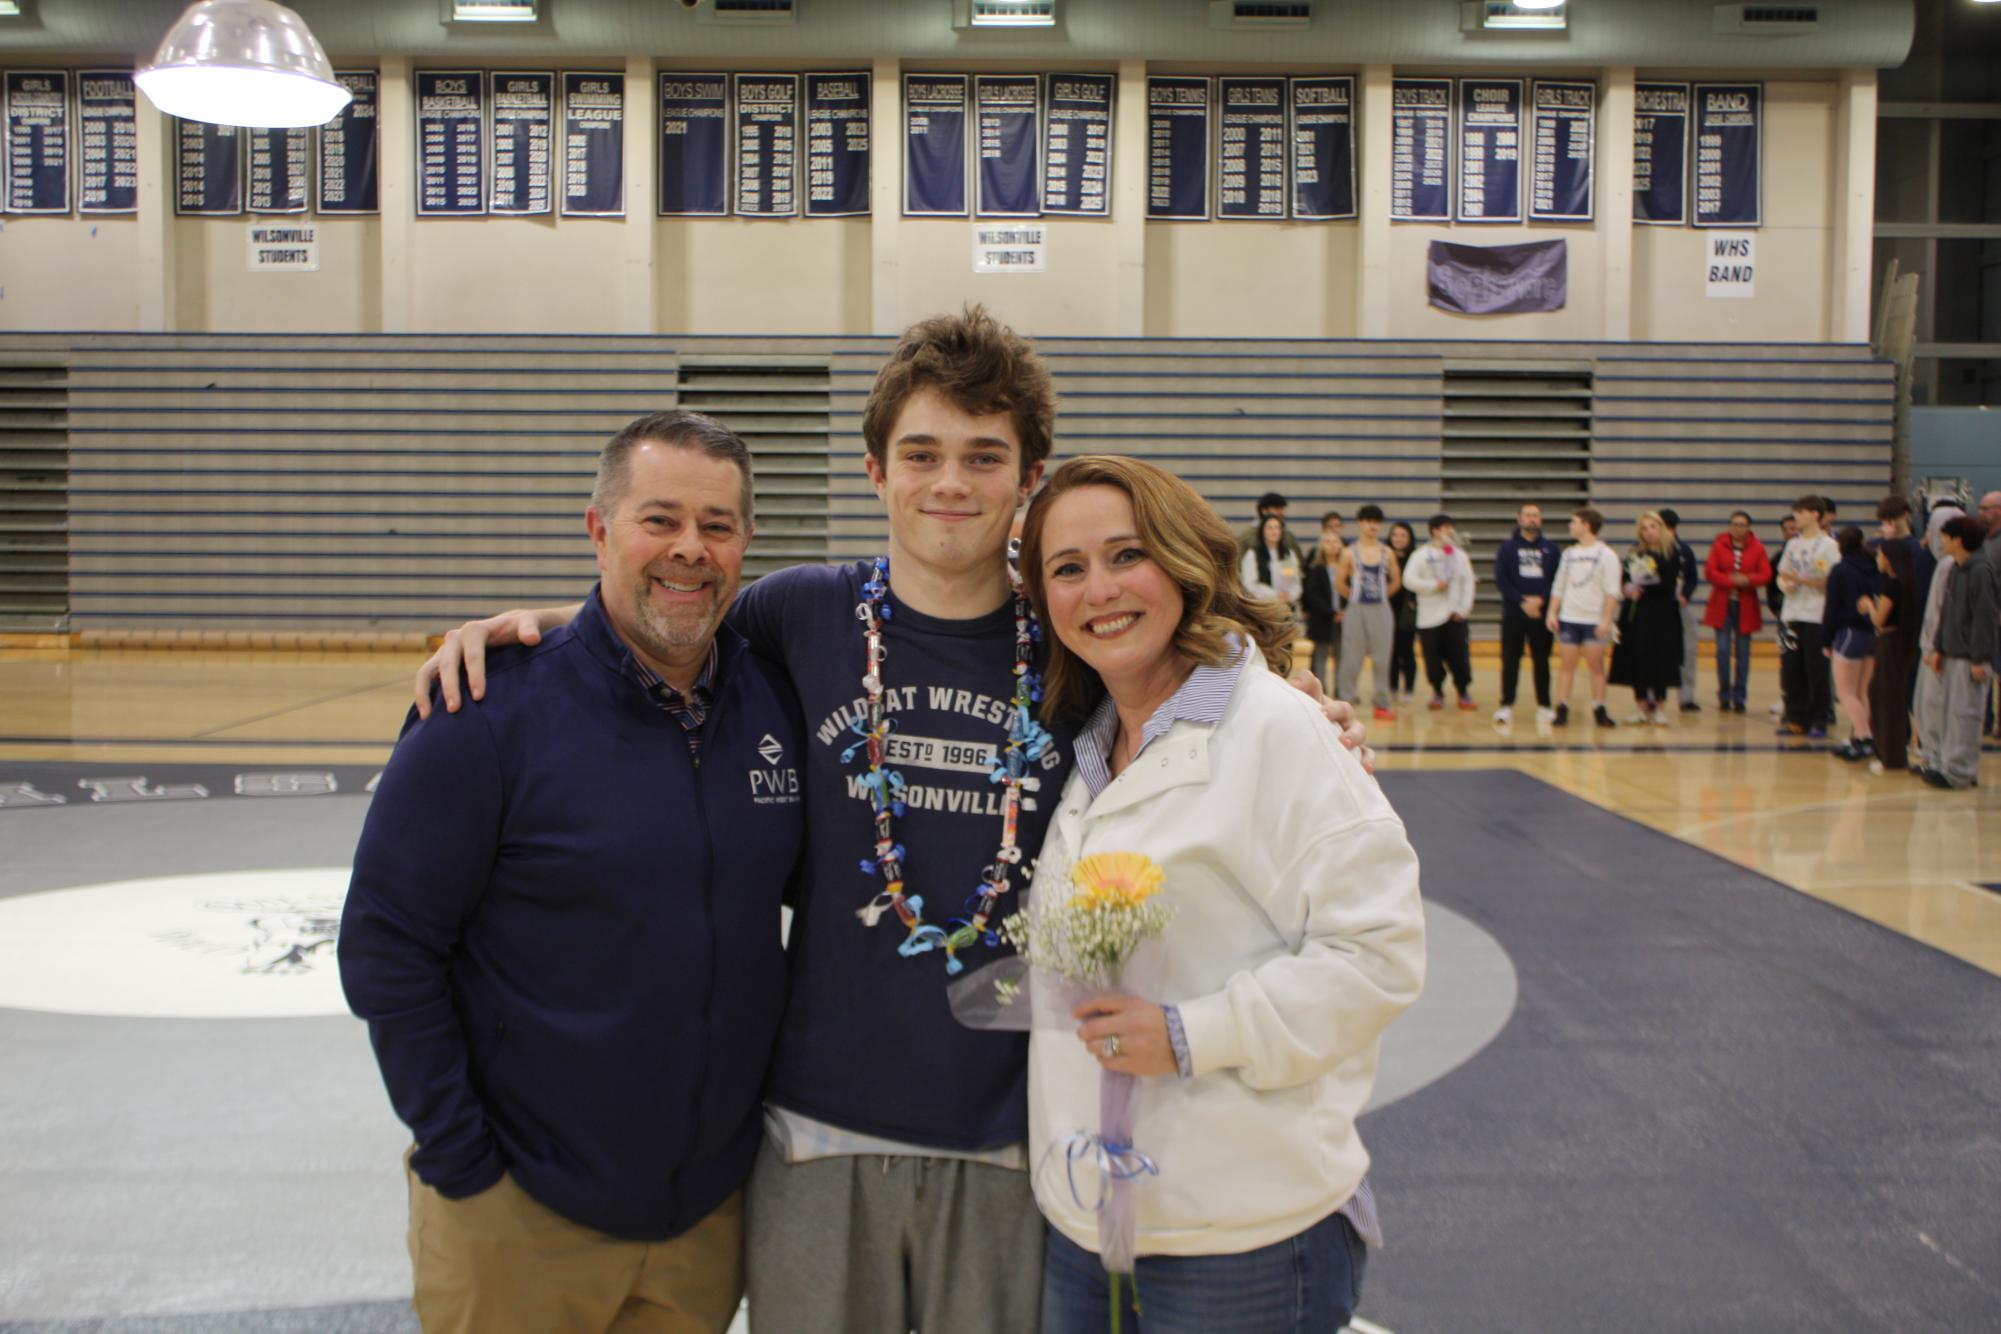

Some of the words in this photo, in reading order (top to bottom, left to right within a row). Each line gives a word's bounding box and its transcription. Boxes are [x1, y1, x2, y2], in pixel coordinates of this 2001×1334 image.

[84, 80, 134, 98] FOOTBALL
[435, 80, 467, 93] BOYS
[507, 81, 540, 92] GIRLS
[580, 82, 610, 93] GIRLS
[664, 83, 694, 98] BOYS
[695, 83, 725, 98] SWIM
[740, 84, 767, 99] BOYS
[767, 84, 794, 99] GOLF
[817, 82, 859, 97] BASEBALL
[1055, 83, 1081, 98] GIRLS
[1081, 83, 1106, 99] GOLF
[496, 93, 548, 104] BASKETBALL
[568, 93, 621, 105] SWIMMING
[1150, 88, 1174, 102] BOYS
[1175, 88, 1206, 102] TENNIS
[1228, 88, 1250, 102] GIRLS
[1250, 88, 1279, 102] TENNIS
[1296, 87, 1349, 103] SOFTBALL
[1394, 89, 1418, 103] BOYS
[1419, 89, 1447, 104] TRACK
[1473, 89, 1510, 102] CHOIR
[1537, 89, 1562, 104] GIRLS
[1563, 90, 1591, 105] TRACK
[1634, 92, 1687, 111] RCHESTRA
[422, 97, 478, 109] BASKETBALL
[739, 104, 794, 113] DISTRICT
[1707, 94, 1749, 111] BAND
[11, 107, 63, 117] DISTRICT
[567, 109, 622, 120] LEAGUE
[1633, 118, 1656, 130] 017
[1259, 128, 1282, 140] 2011
[810, 156, 834, 170] 2011
[183, 166, 206, 178] 2013
[183, 180, 206, 192] 2014
[810, 186, 835, 200] 2022
[183, 194, 206, 206] 2015
[252, 230, 314, 243] WILSONVILLE
[978, 231, 1041, 244] WILSONVILLE
[1714, 239, 1750, 256] WHS
[258, 250, 308, 263] STUDENTS
[985, 251, 1034, 265] STUDENTS
[1708, 265, 1753, 282] BAND
[816, 686, 917, 746] WILDAT
[943, 745, 988, 767] 1996
[749, 768, 800, 795] PWB
[846, 775, 1010, 816] WSONVILL
